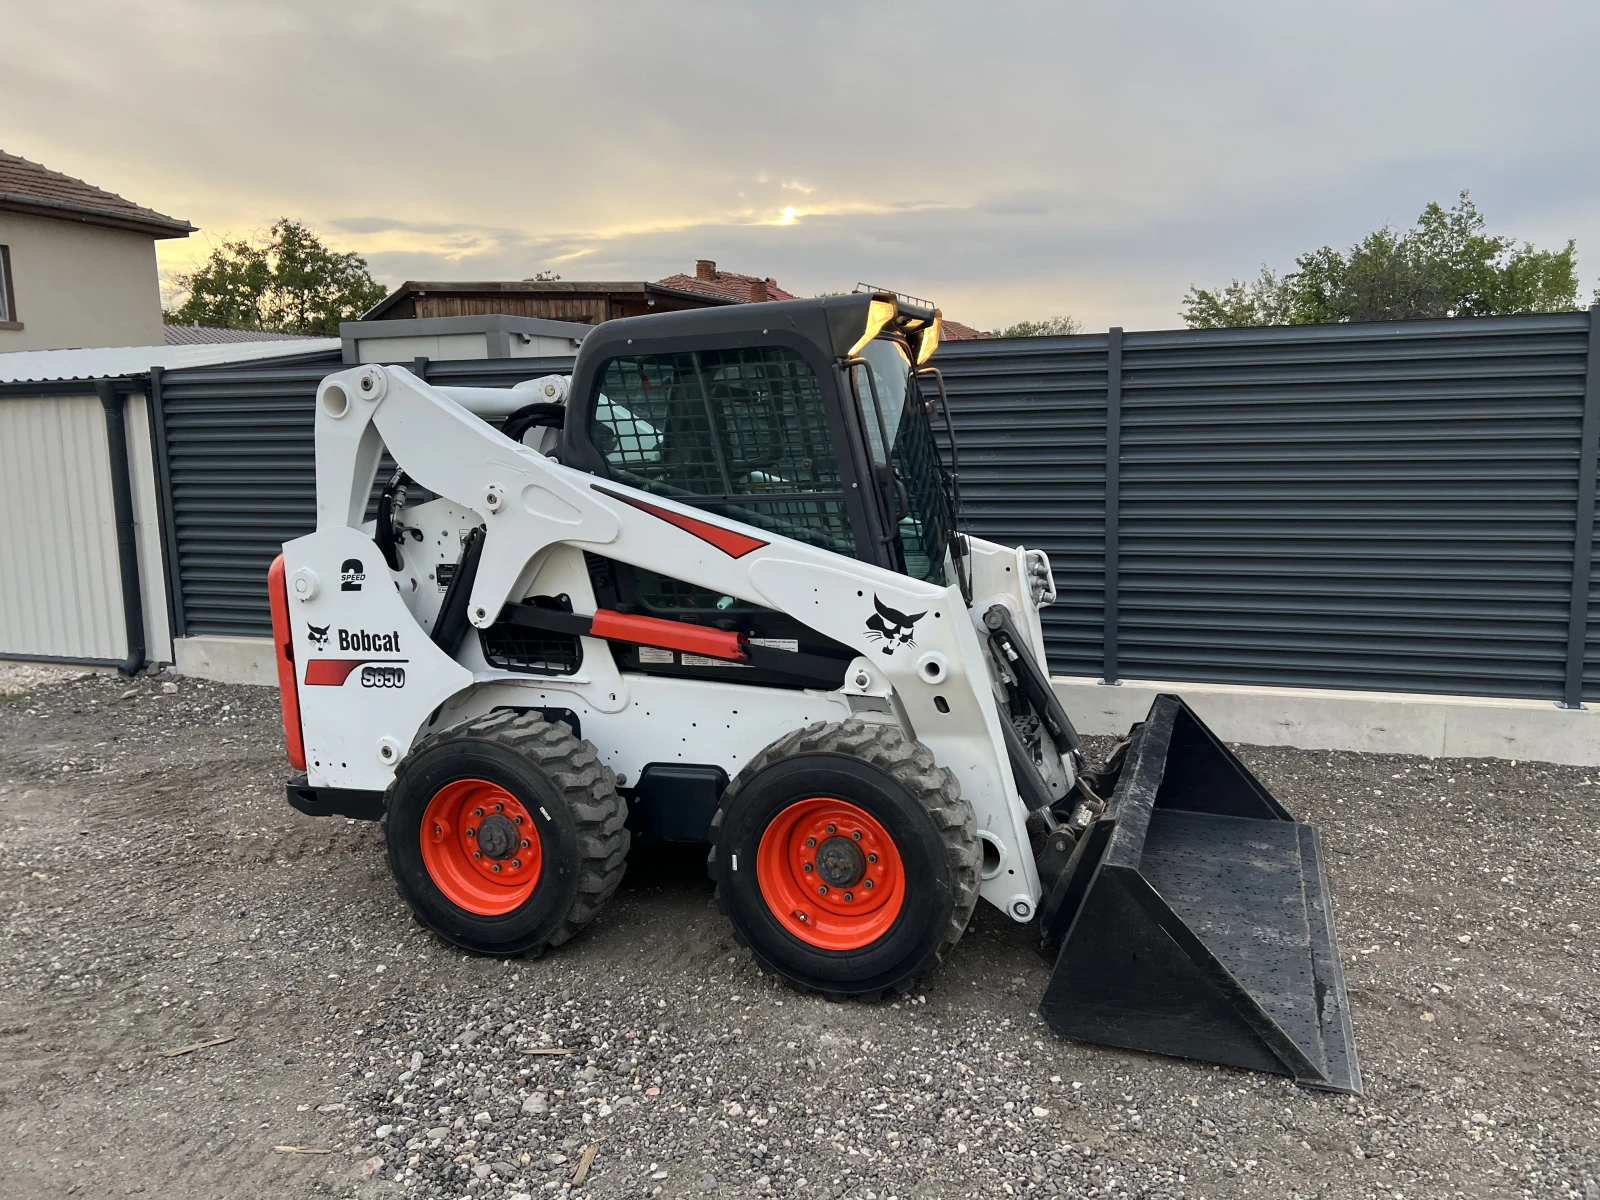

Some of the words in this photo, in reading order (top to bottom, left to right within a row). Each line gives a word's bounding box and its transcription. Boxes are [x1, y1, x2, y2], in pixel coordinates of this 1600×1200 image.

[341, 559, 363, 591] 2
[338, 629, 401, 652] Bobcat
[361, 666, 405, 688] S650
